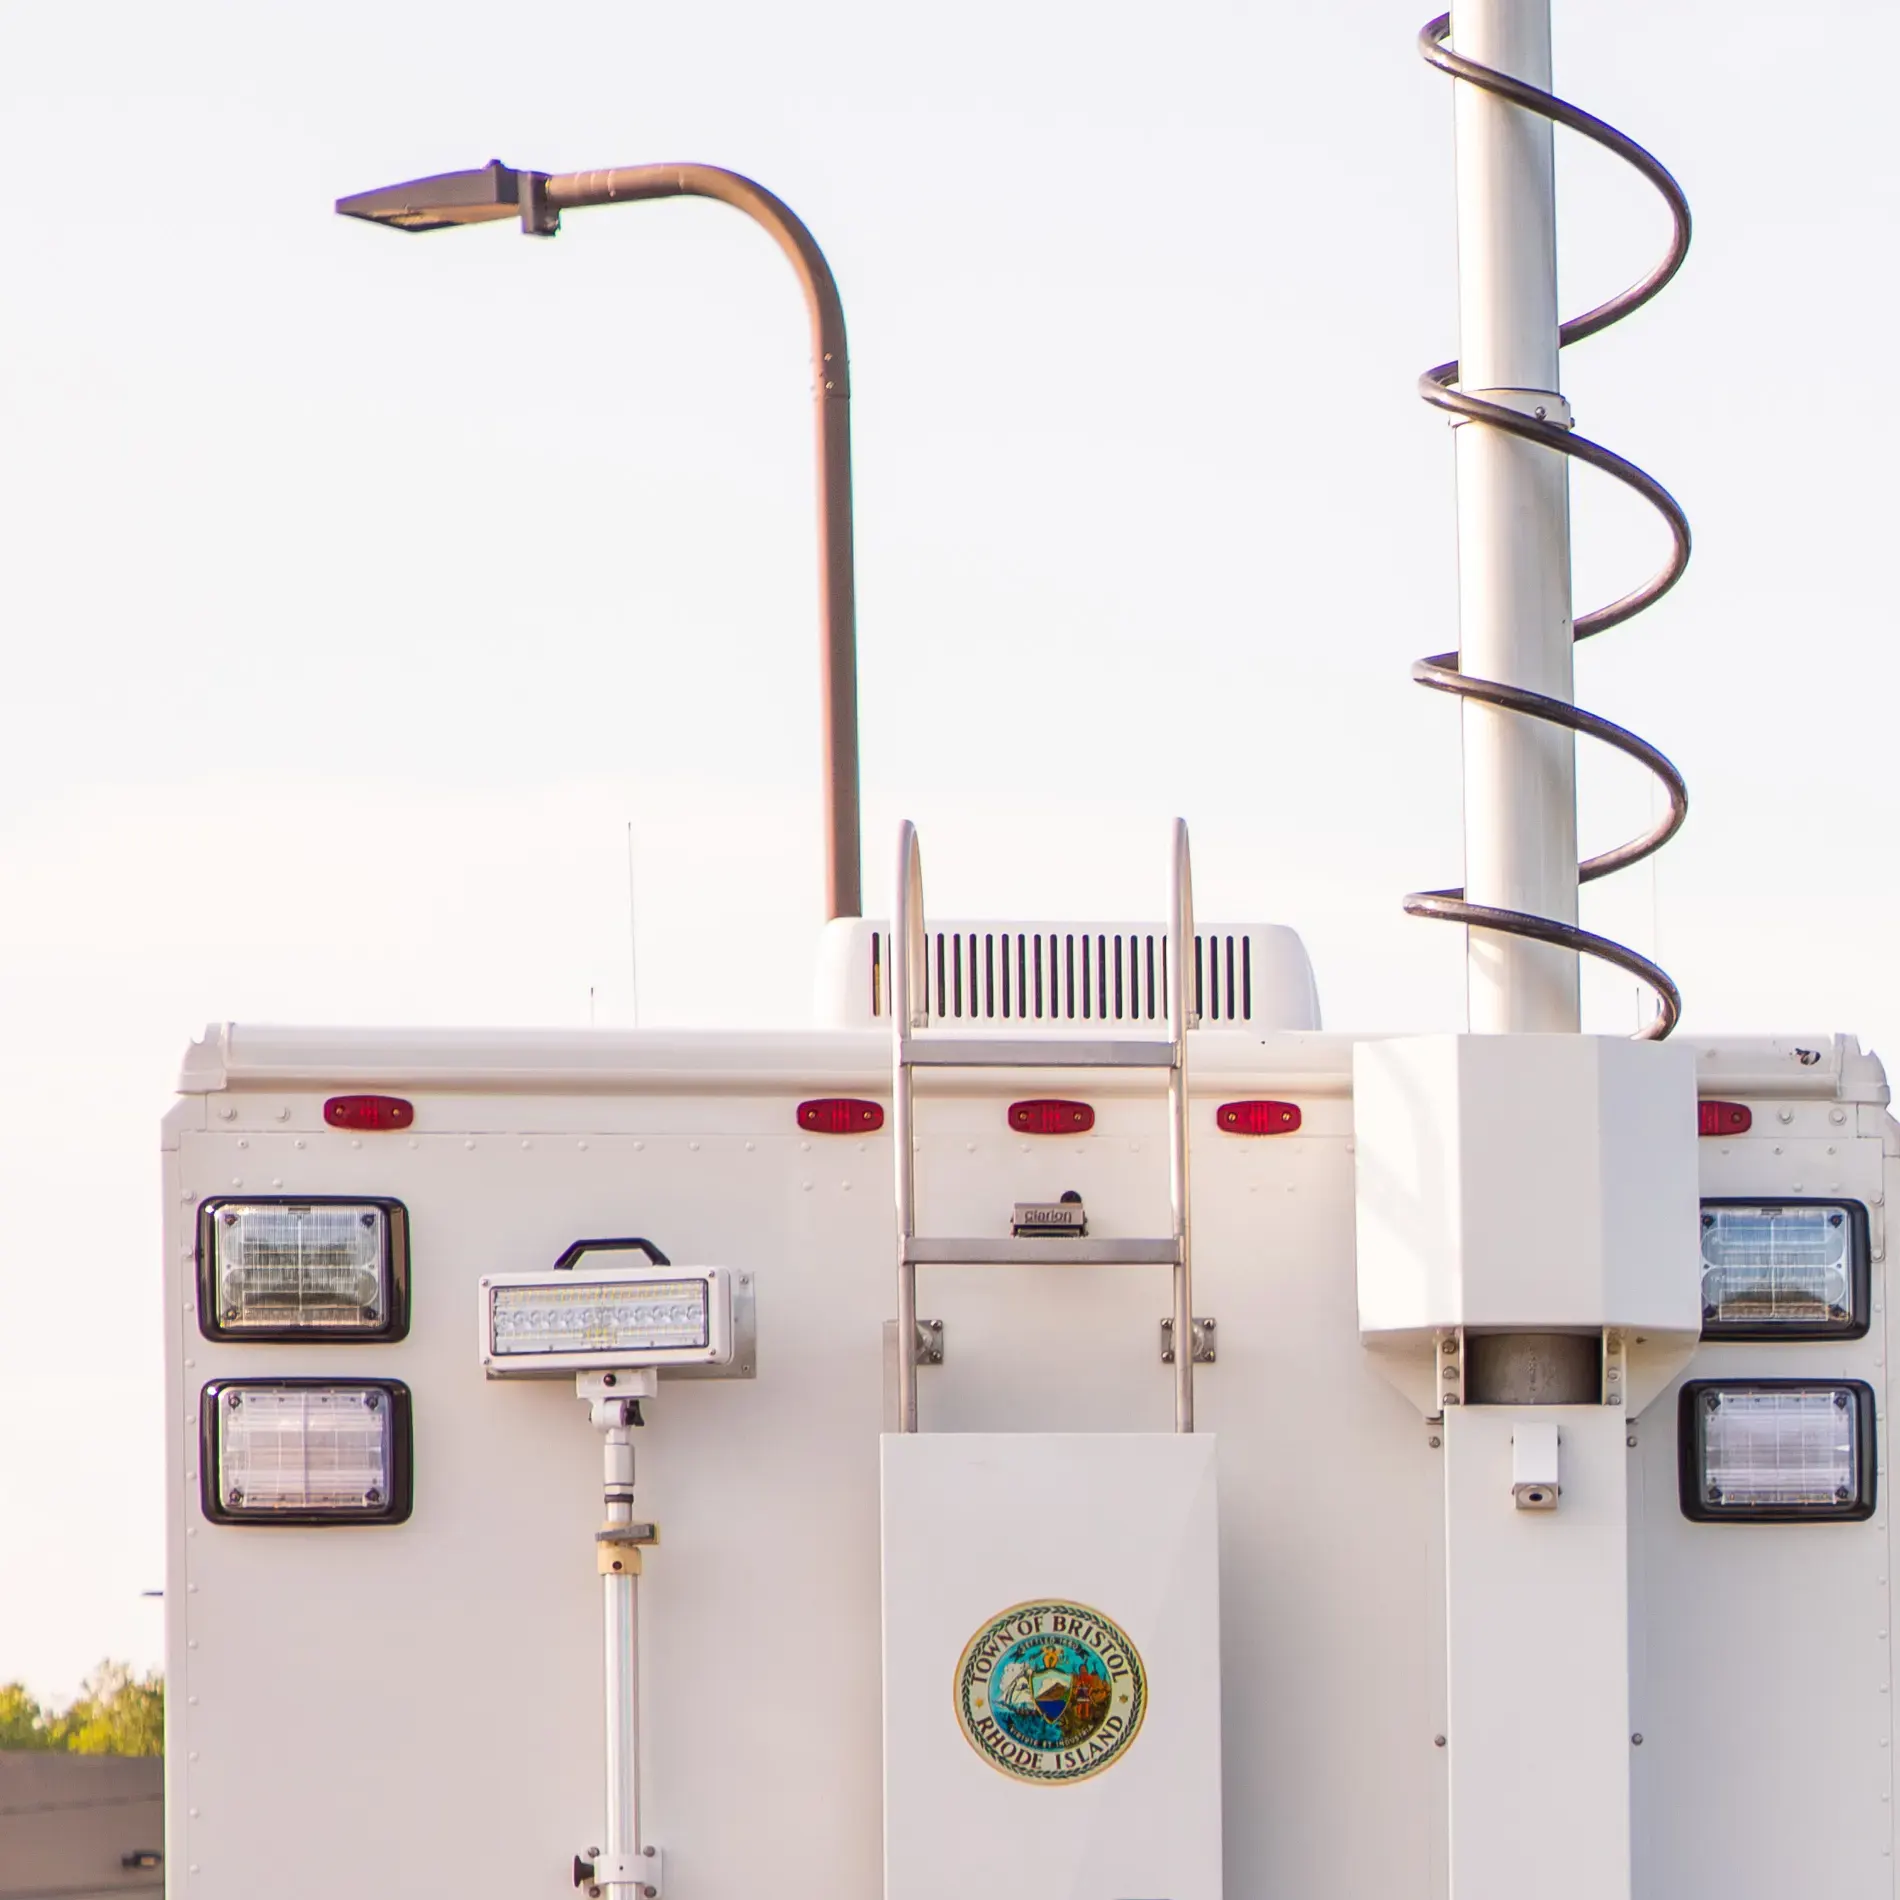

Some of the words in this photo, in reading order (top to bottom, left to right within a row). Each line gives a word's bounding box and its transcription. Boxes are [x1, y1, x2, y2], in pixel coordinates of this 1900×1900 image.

[970, 1629, 1014, 1685] TOWN
[1017, 1616, 1043, 1635] OF
[1053, 1616, 1130, 1683] BRISTOL
[976, 1716, 1043, 1769] RHODE
[1055, 1715, 1123, 1770] ISLAND
